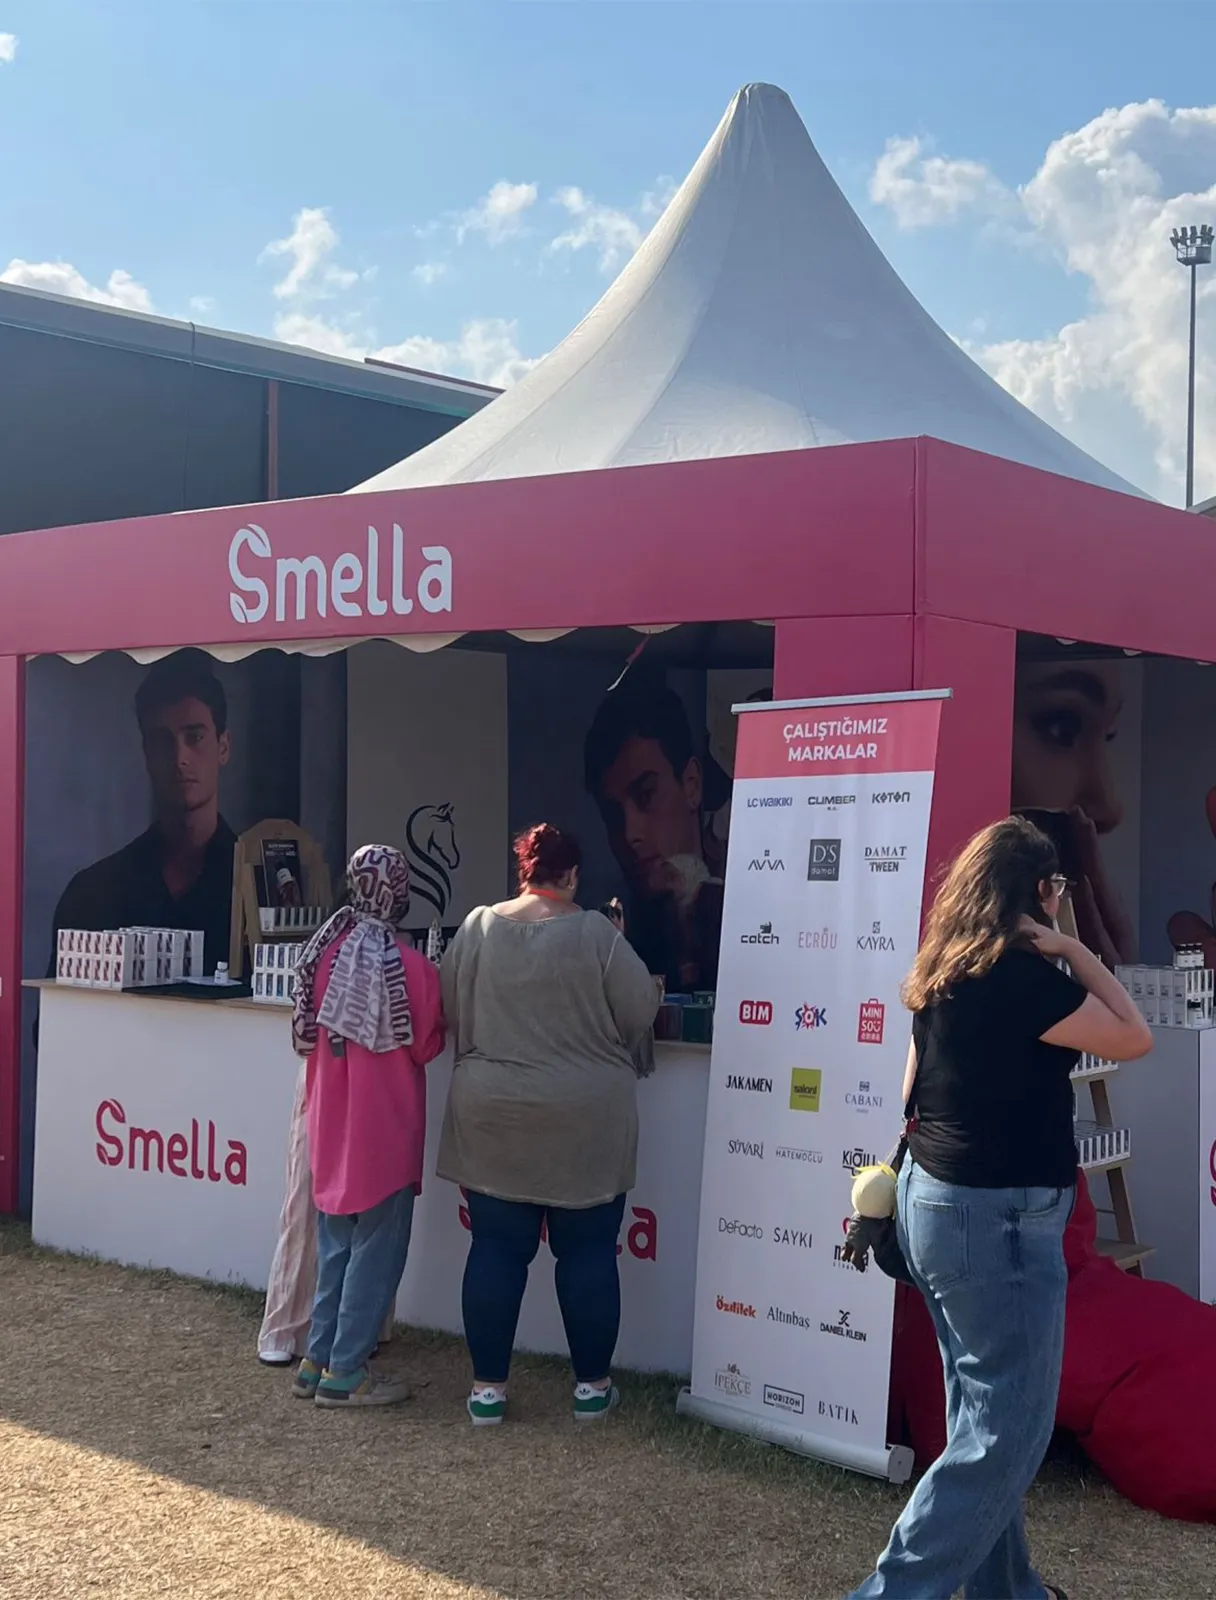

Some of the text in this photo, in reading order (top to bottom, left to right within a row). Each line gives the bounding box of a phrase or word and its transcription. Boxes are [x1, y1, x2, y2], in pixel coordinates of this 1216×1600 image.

[228, 523, 453, 624] Smella
[783, 717, 888, 743] ÇALIŞTIĞIMIZ
[788, 743, 878, 762] MARKALAR
[747, 798, 758, 808] LC
[808, 795, 856, 805] CLIMBER
[864, 846, 907, 858] DAMAT
[748, 859, 785, 871] AVVA
[869, 862, 899, 873] TWEEN
[740, 933, 780, 945] catch
[856, 935, 895, 951] KAYRA
[862, 1007, 883, 1019] MINI
[725, 1074, 773, 1093] JAKAMEN
[845, 1093, 883, 1107] CABANI
[96, 1098, 248, 1186] Smella
[773, 1227, 812, 1248] SAYKI
[766, 1306, 811, 1330] Altınbaş
[820, 1322, 867, 1342] DANIEL KLEIN
